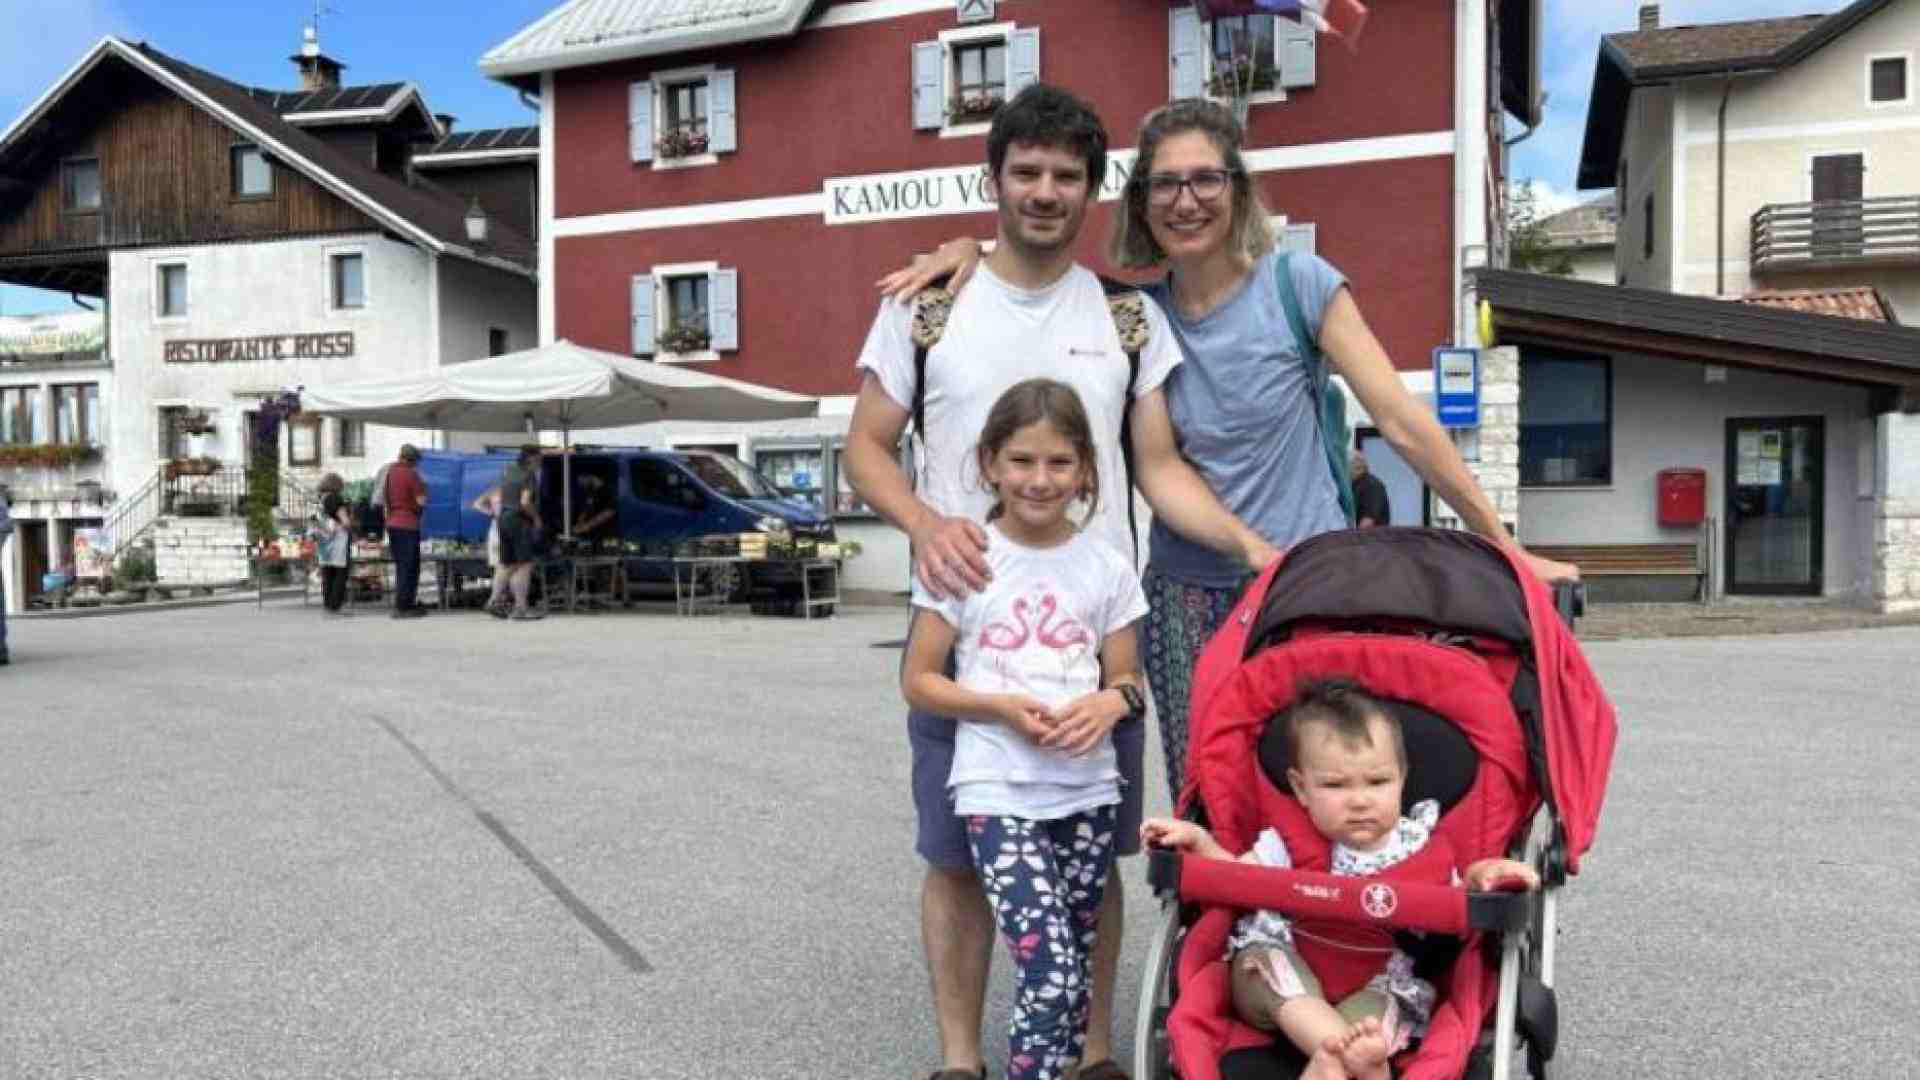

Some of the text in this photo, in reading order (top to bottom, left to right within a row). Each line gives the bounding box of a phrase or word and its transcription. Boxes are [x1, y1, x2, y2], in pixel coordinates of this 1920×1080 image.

[832, 177, 944, 216] KAMOU
[165, 331, 354, 363] RISTORANTE ROSSI
